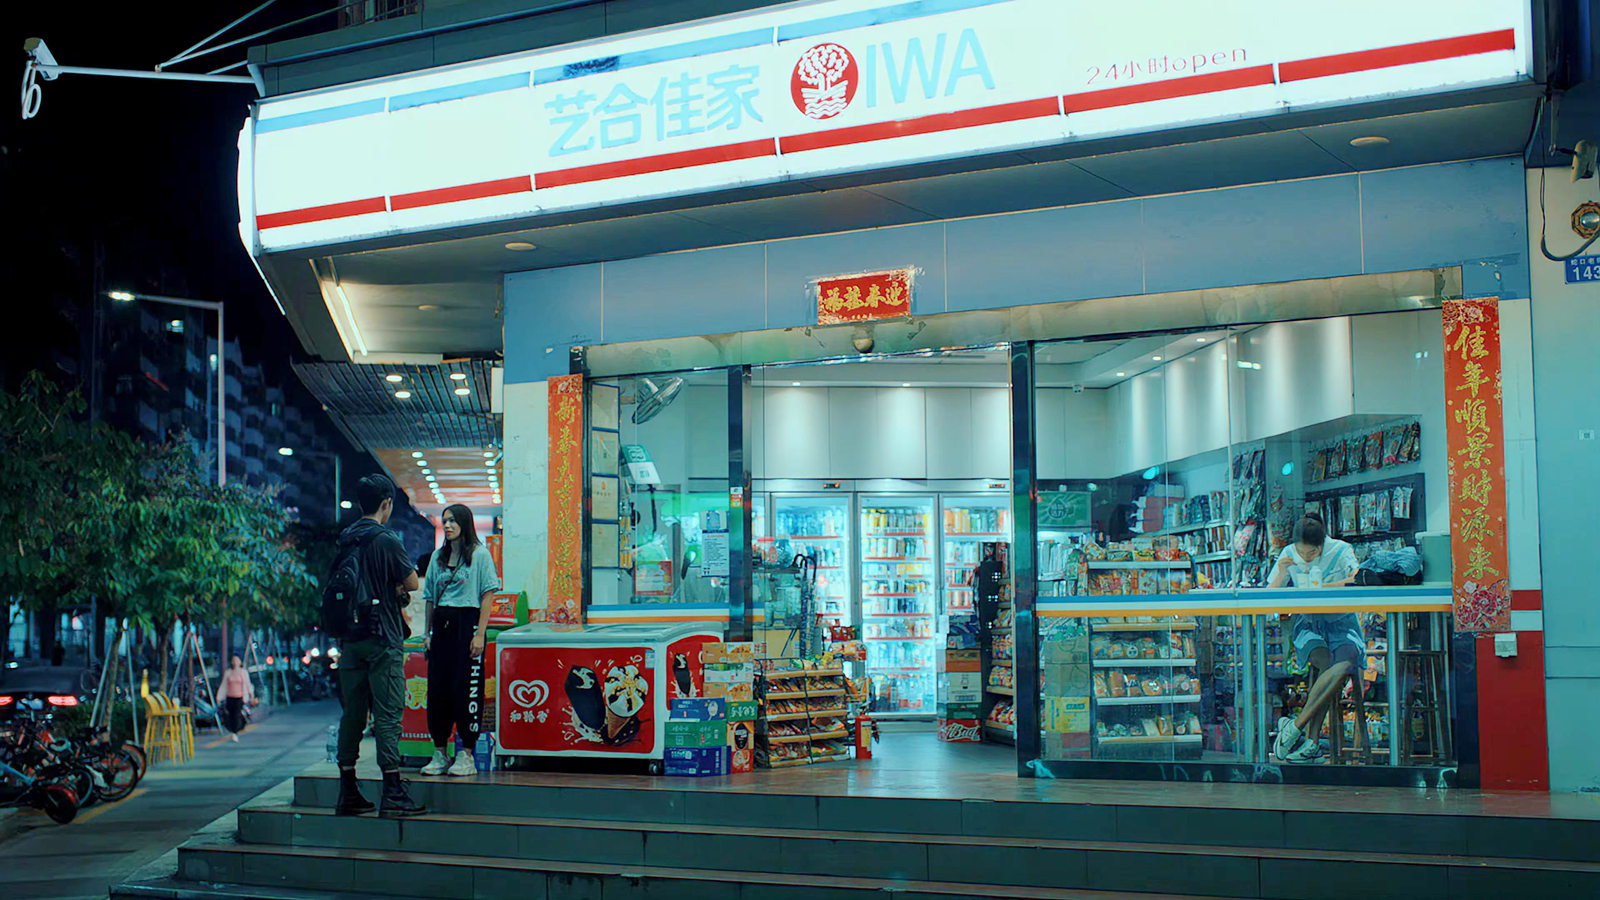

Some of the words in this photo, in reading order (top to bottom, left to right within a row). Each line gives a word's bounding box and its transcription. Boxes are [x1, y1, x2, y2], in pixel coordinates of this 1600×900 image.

[544, 64, 763, 157] 艺合佳家
[866, 28, 996, 108] IWA
